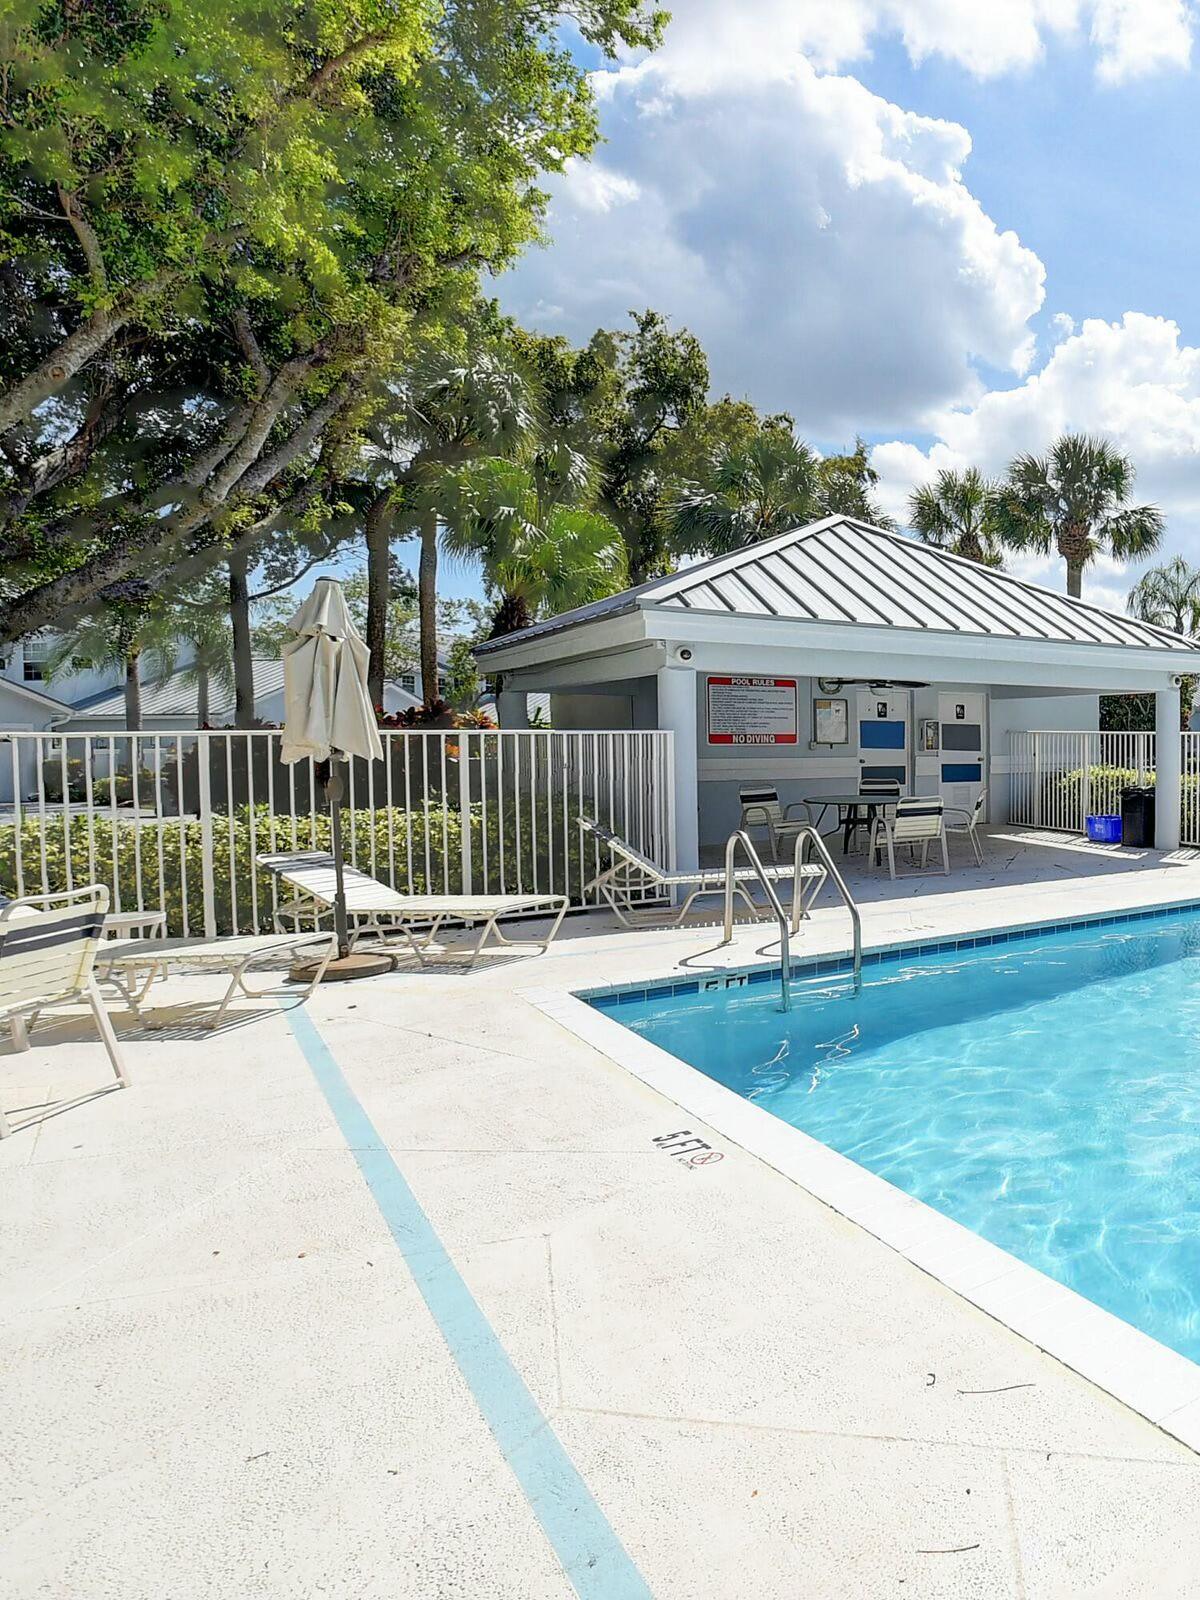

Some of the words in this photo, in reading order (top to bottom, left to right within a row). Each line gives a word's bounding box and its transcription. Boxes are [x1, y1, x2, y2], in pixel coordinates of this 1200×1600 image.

[731, 678, 751, 686] POOL
[732, 734, 745, 744] NO
[746, 734, 776, 744] DIVING
[652, 1130, 693, 1143] 5
[661, 1138, 712, 1157] FT
